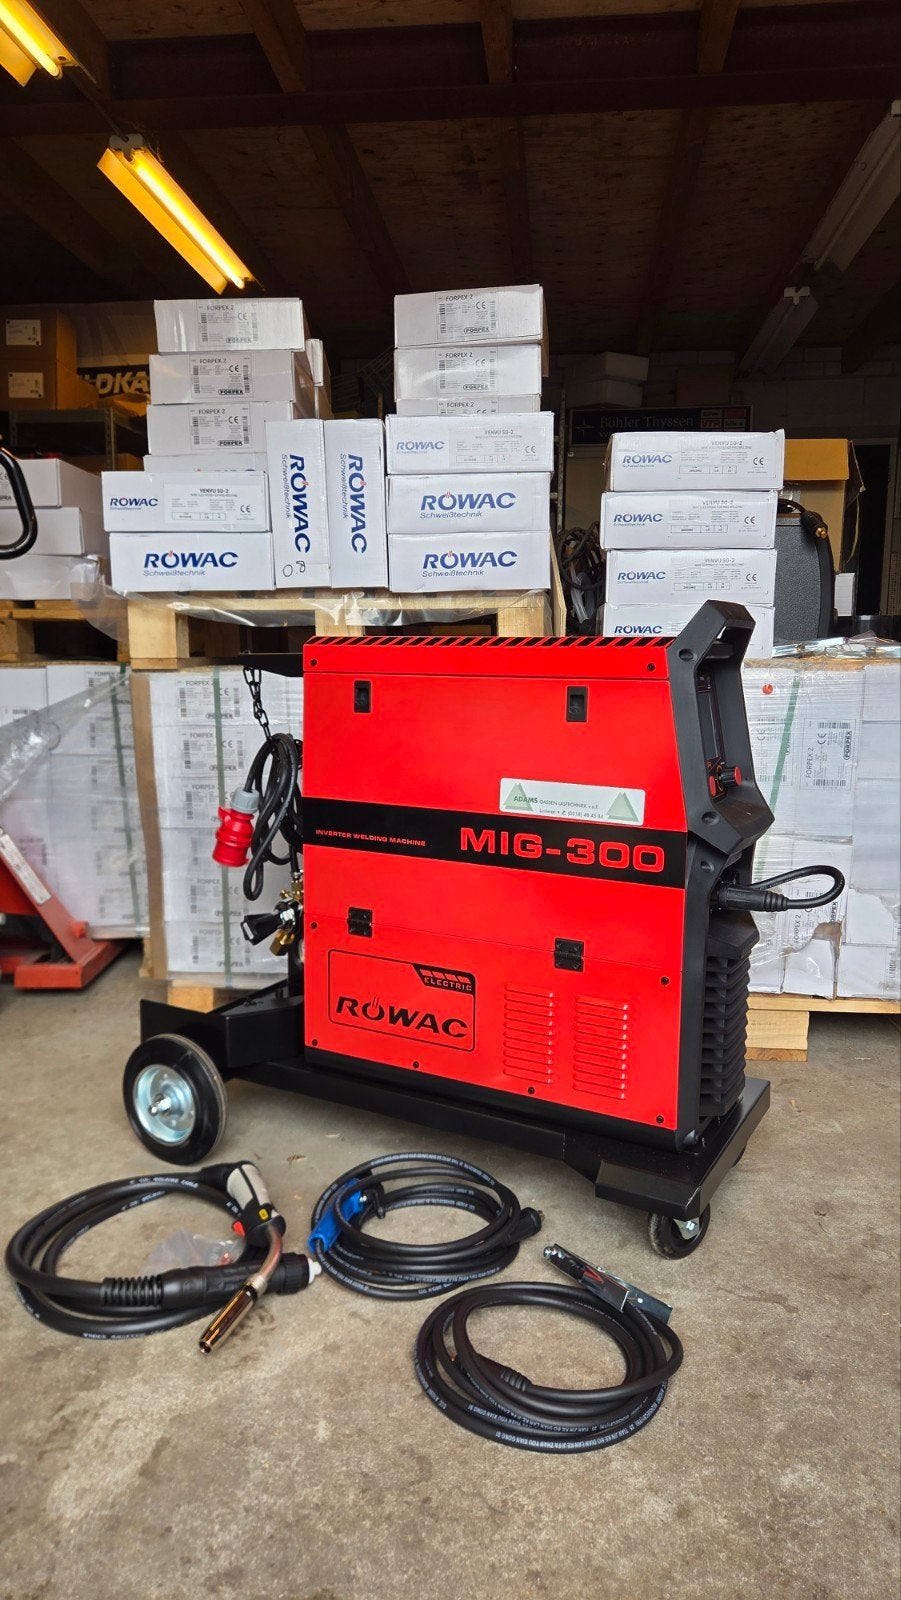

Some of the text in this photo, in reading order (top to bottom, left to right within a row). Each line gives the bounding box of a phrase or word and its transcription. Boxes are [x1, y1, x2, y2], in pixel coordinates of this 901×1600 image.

[446, 294, 468, 302] FORPEX
[600, 416, 639, 429] Böhler
[642, 415, 694, 428] Thyssen
[396, 441, 445, 450] ROWAC
[622, 454, 673, 463] ROWAC
[110, 497, 158, 507] ROWAC
[290, 454, 311, 554] ROWAC
[348, 454, 367, 554] ROWAC
[421, 492, 516, 510] ROWAC
[614, 514, 663, 522] ROWAC
[144, 552, 238, 568] ROWAC
[422, 551, 518, 569] ROWAC
[617, 572, 666, 580] ROWAC
[614, 625, 662, 634] ROWAC
[316, 829, 426, 846] INVERTER WELDING MACHINE
[460, 827, 664, 873] MIG-300
[424, 977, 472, 991] ELECTRIC
[336, 996, 468, 1038] ROWAC
